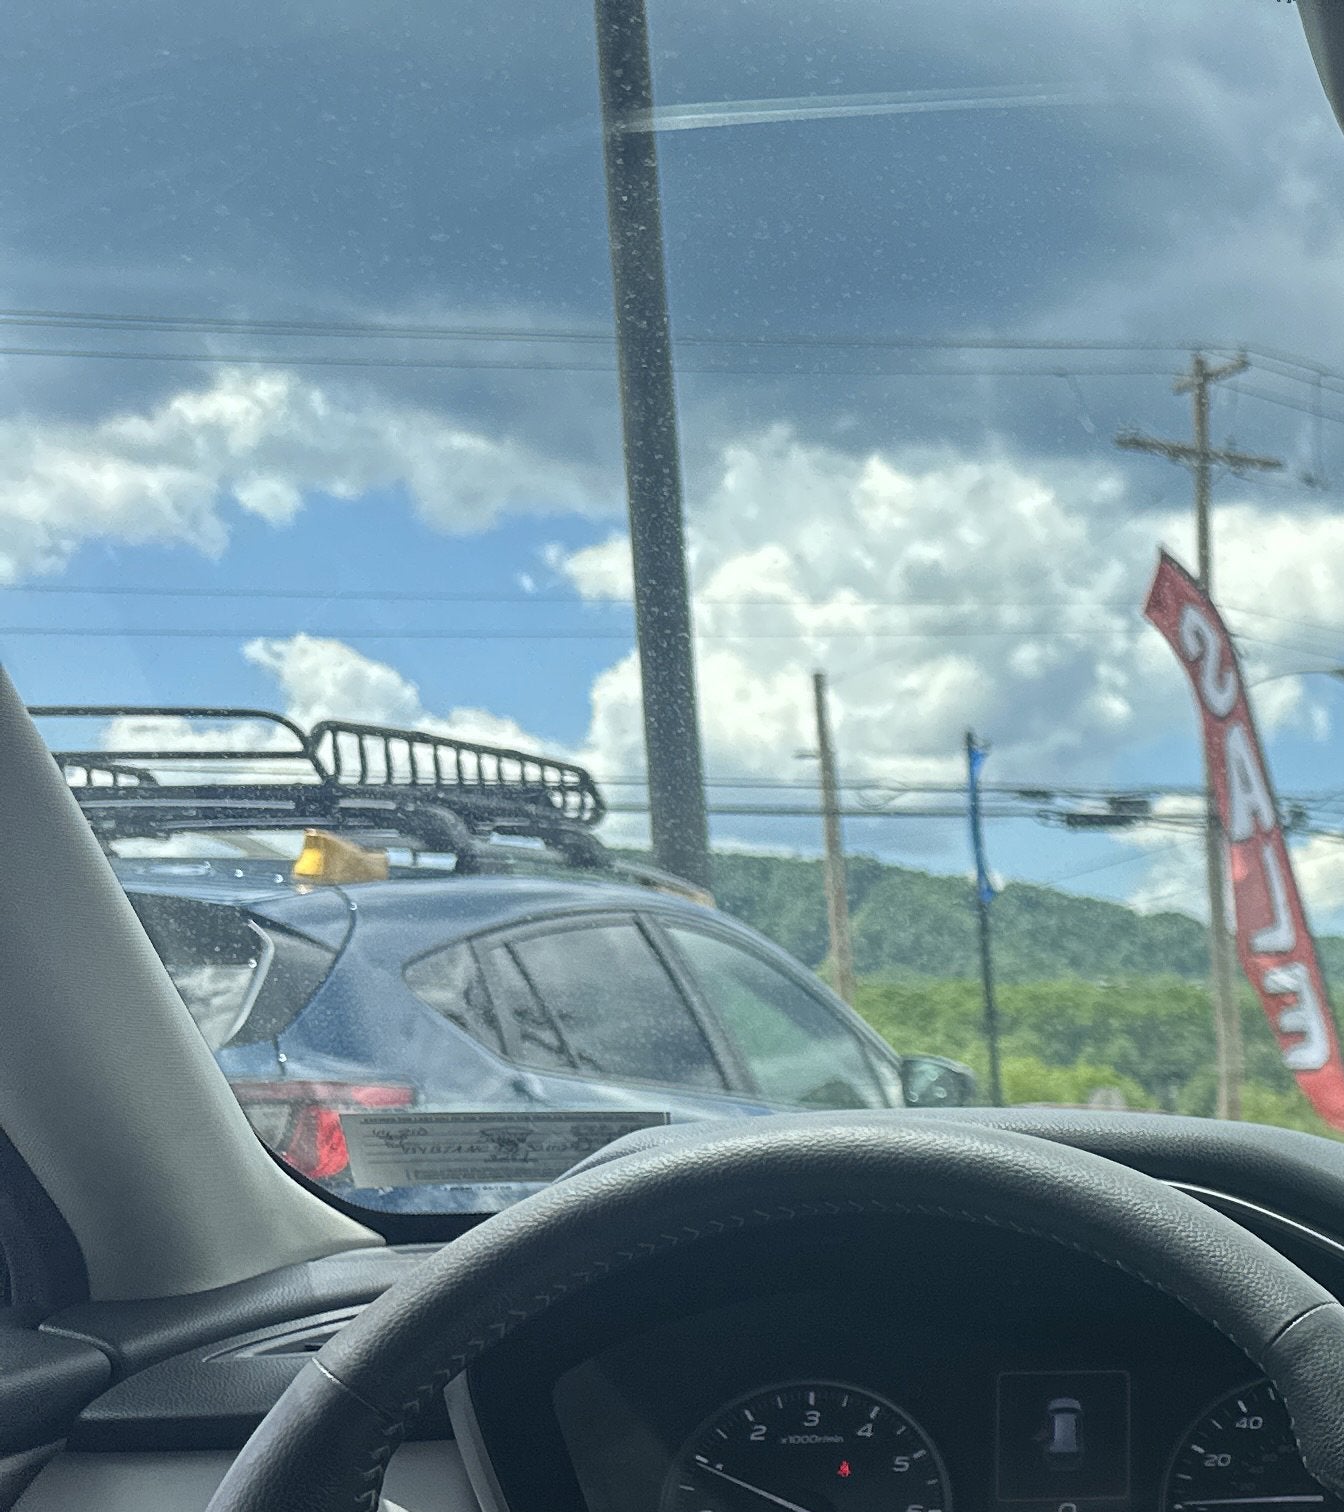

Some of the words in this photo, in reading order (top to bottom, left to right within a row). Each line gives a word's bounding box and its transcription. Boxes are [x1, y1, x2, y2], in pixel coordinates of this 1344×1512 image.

[804, 1410, 820, 1427] 3
[1235, 1416, 1263, 1430] 40
[750, 1425, 767, 1441] 2
[857, 1422, 873, 1438] 4
[892, 1456, 910, 1472] 5
[1204, 1454, 1232, 1468] 20
